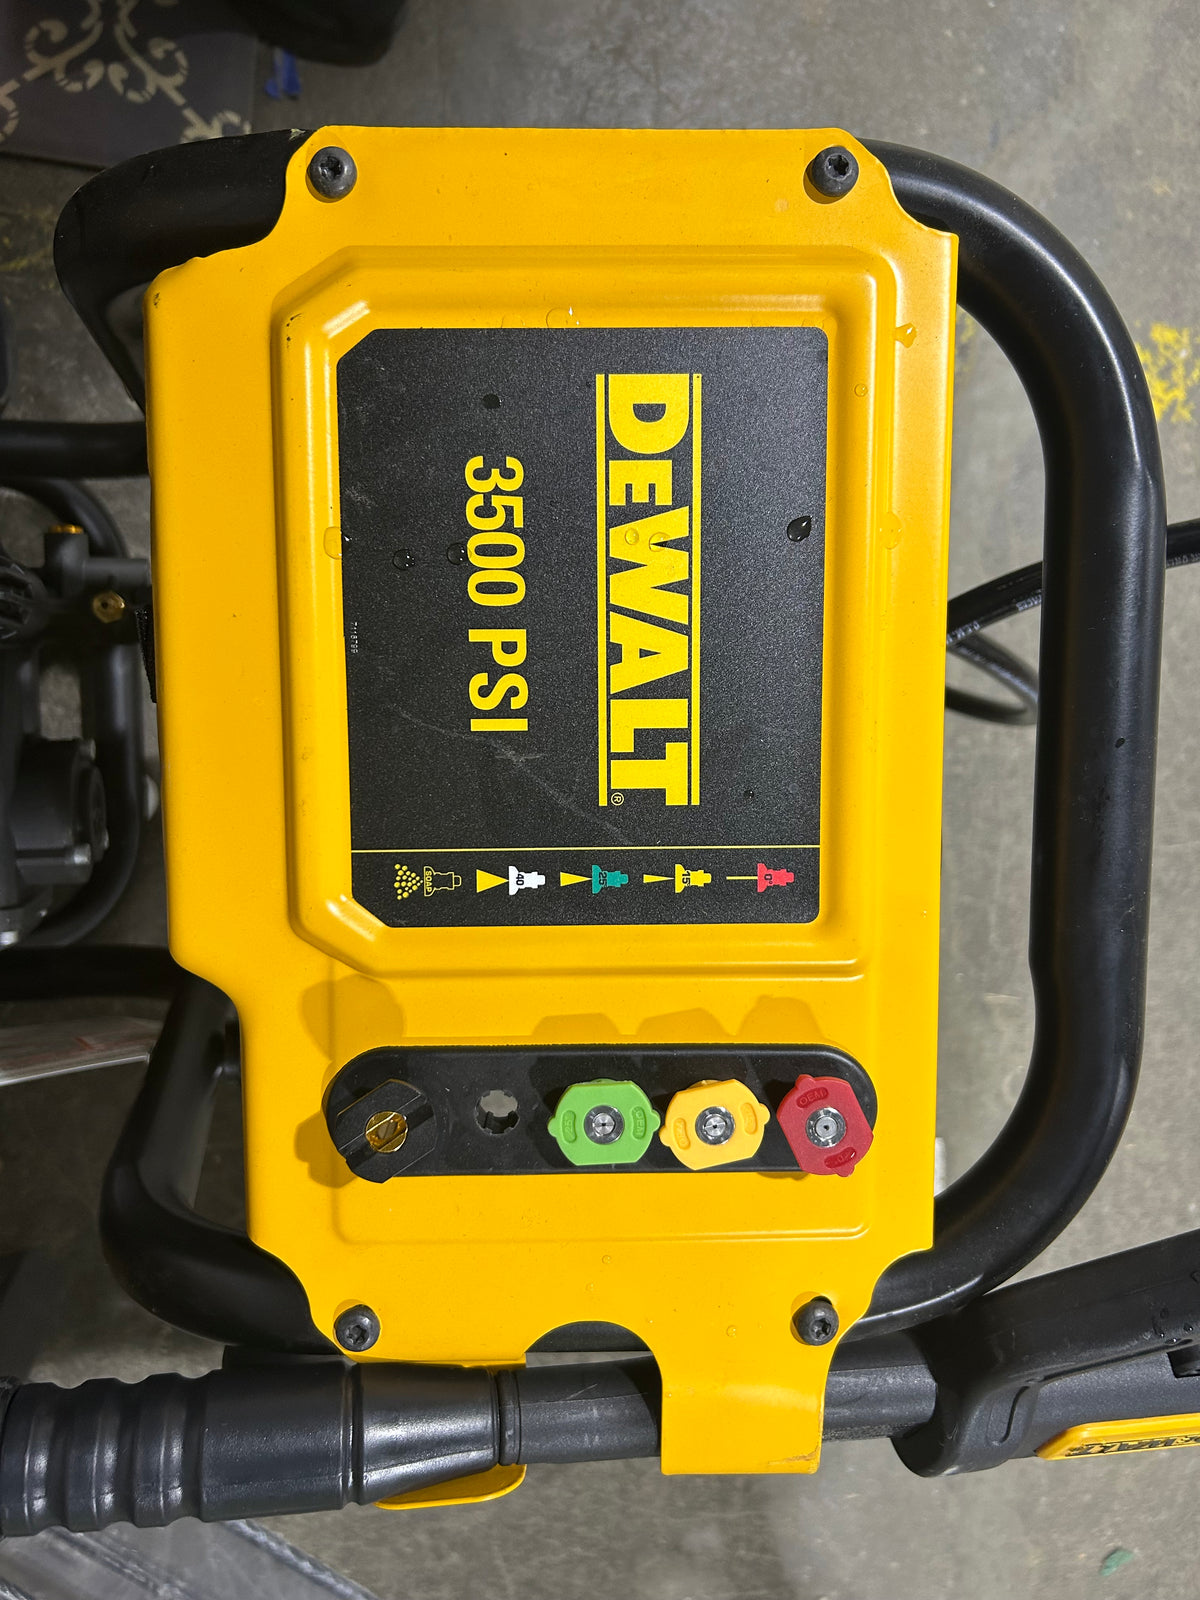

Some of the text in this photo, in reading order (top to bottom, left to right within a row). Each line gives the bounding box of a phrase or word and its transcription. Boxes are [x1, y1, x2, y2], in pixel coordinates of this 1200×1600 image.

[464, 455, 529, 733] 3500 PSI
[608, 373, 692, 807] DEWALT
[425, 870, 433, 892] SOAP
